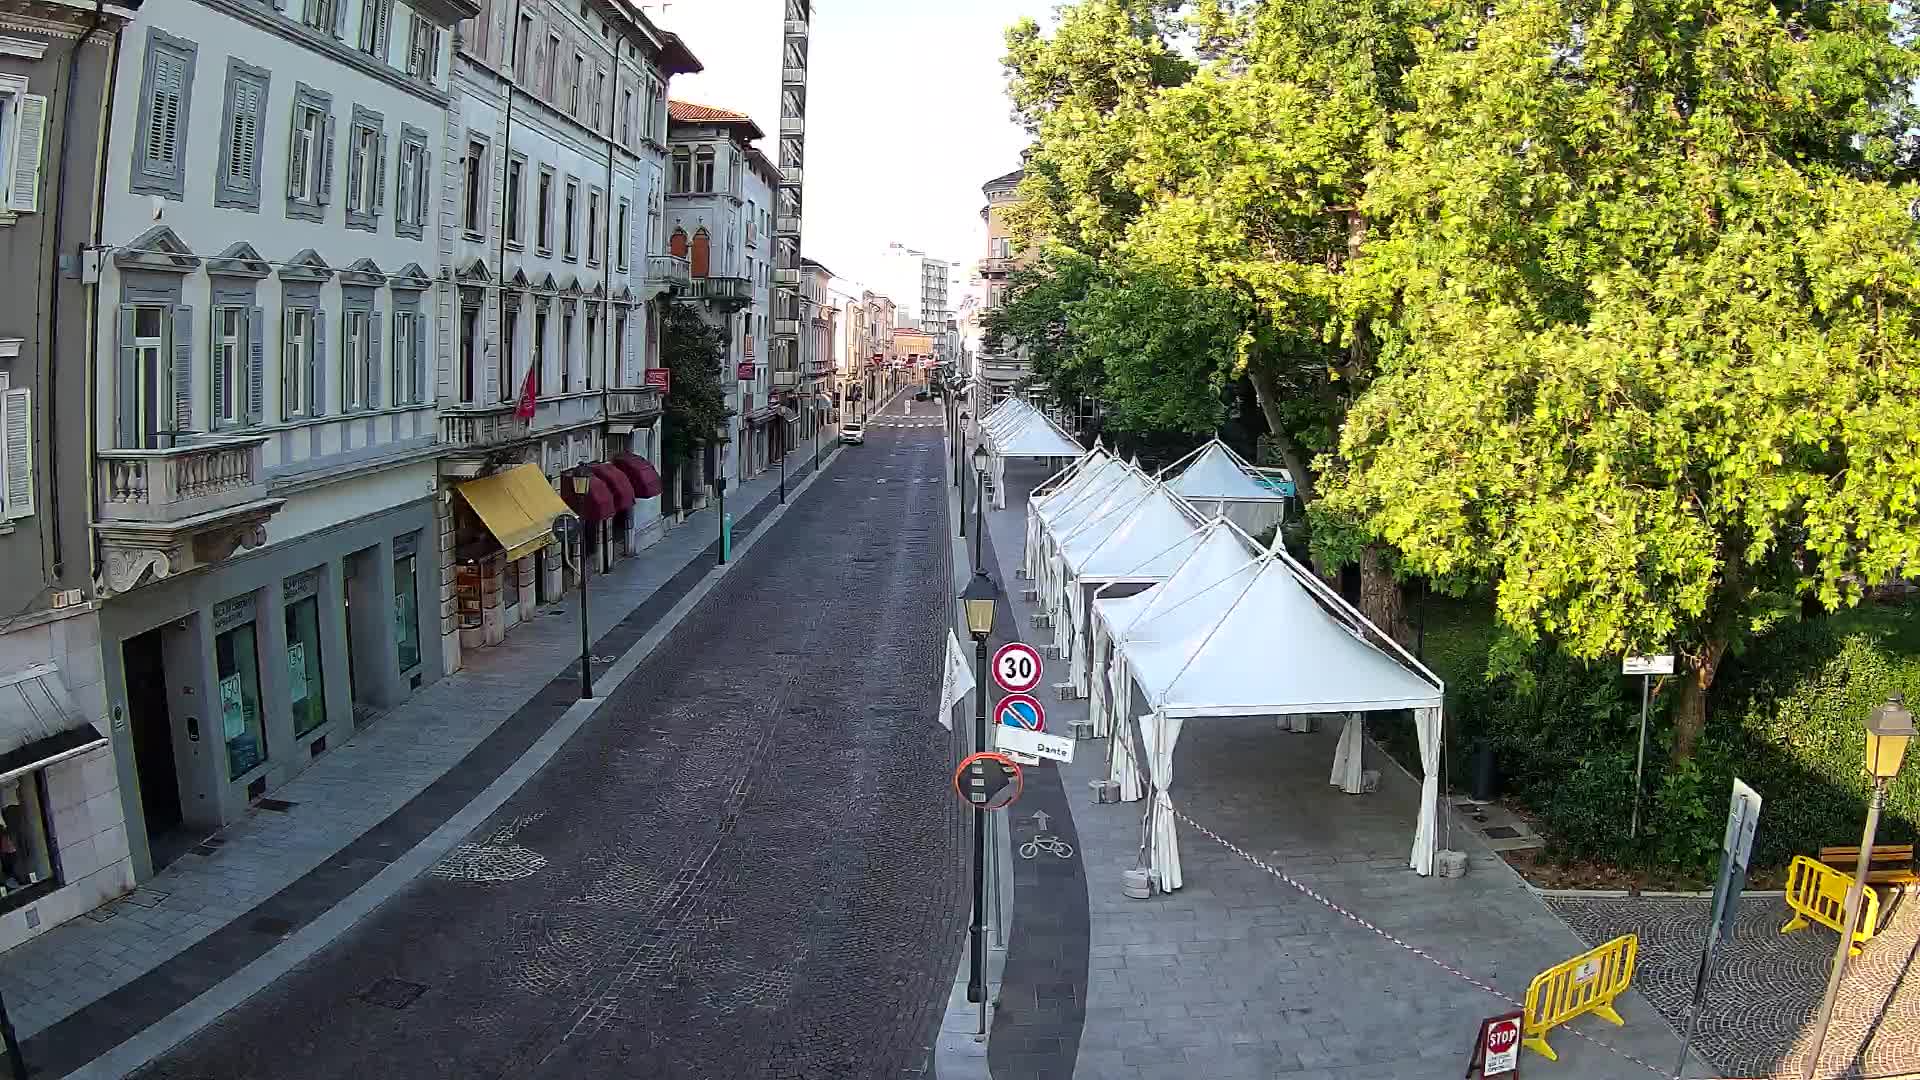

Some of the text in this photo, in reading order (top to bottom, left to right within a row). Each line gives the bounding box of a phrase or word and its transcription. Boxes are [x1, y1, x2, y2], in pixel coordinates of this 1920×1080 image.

[1005, 657, 1031, 679] 30
[1037, 743, 1067, 757] Dante
[1490, 1030, 1516, 1047] STOP
